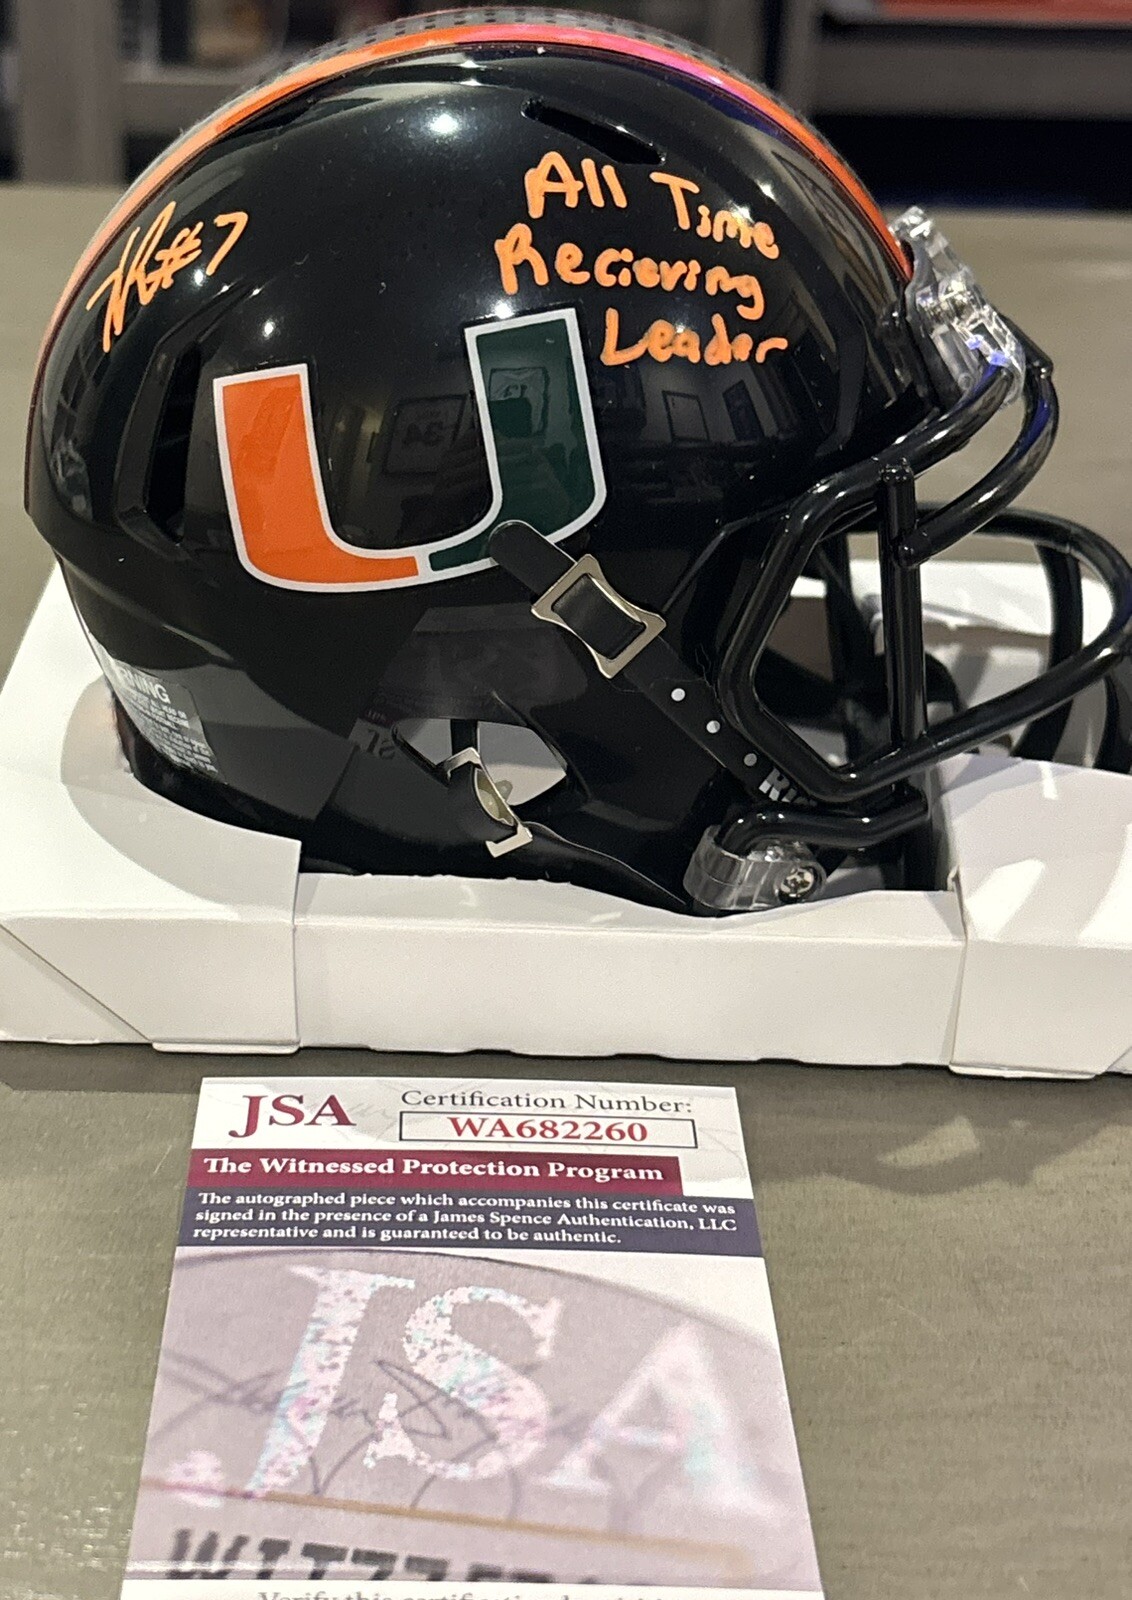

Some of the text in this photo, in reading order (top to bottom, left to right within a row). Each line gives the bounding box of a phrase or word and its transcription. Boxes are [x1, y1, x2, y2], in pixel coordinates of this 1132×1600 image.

[524, 151, 780, 260] All Time
[600, 307, 789, 367] Leader
[401, 1089, 692, 1113] Certification Number:
[228, 1094, 357, 1138] JSA
[447, 1116, 648, 1142] WA682260
[203, 1157, 664, 1183] The Witnessed Protection Program
[198, 1192, 736, 1214] The autographed piece which accompanies this certificate was
[195, 1208, 738, 1231] signed in the presence of a James Spence Authentication, LLC
[193, 1226, 622, 1244] representative and is guaranteed to be authentic.
[164, 1263, 790, 1535] JSA
